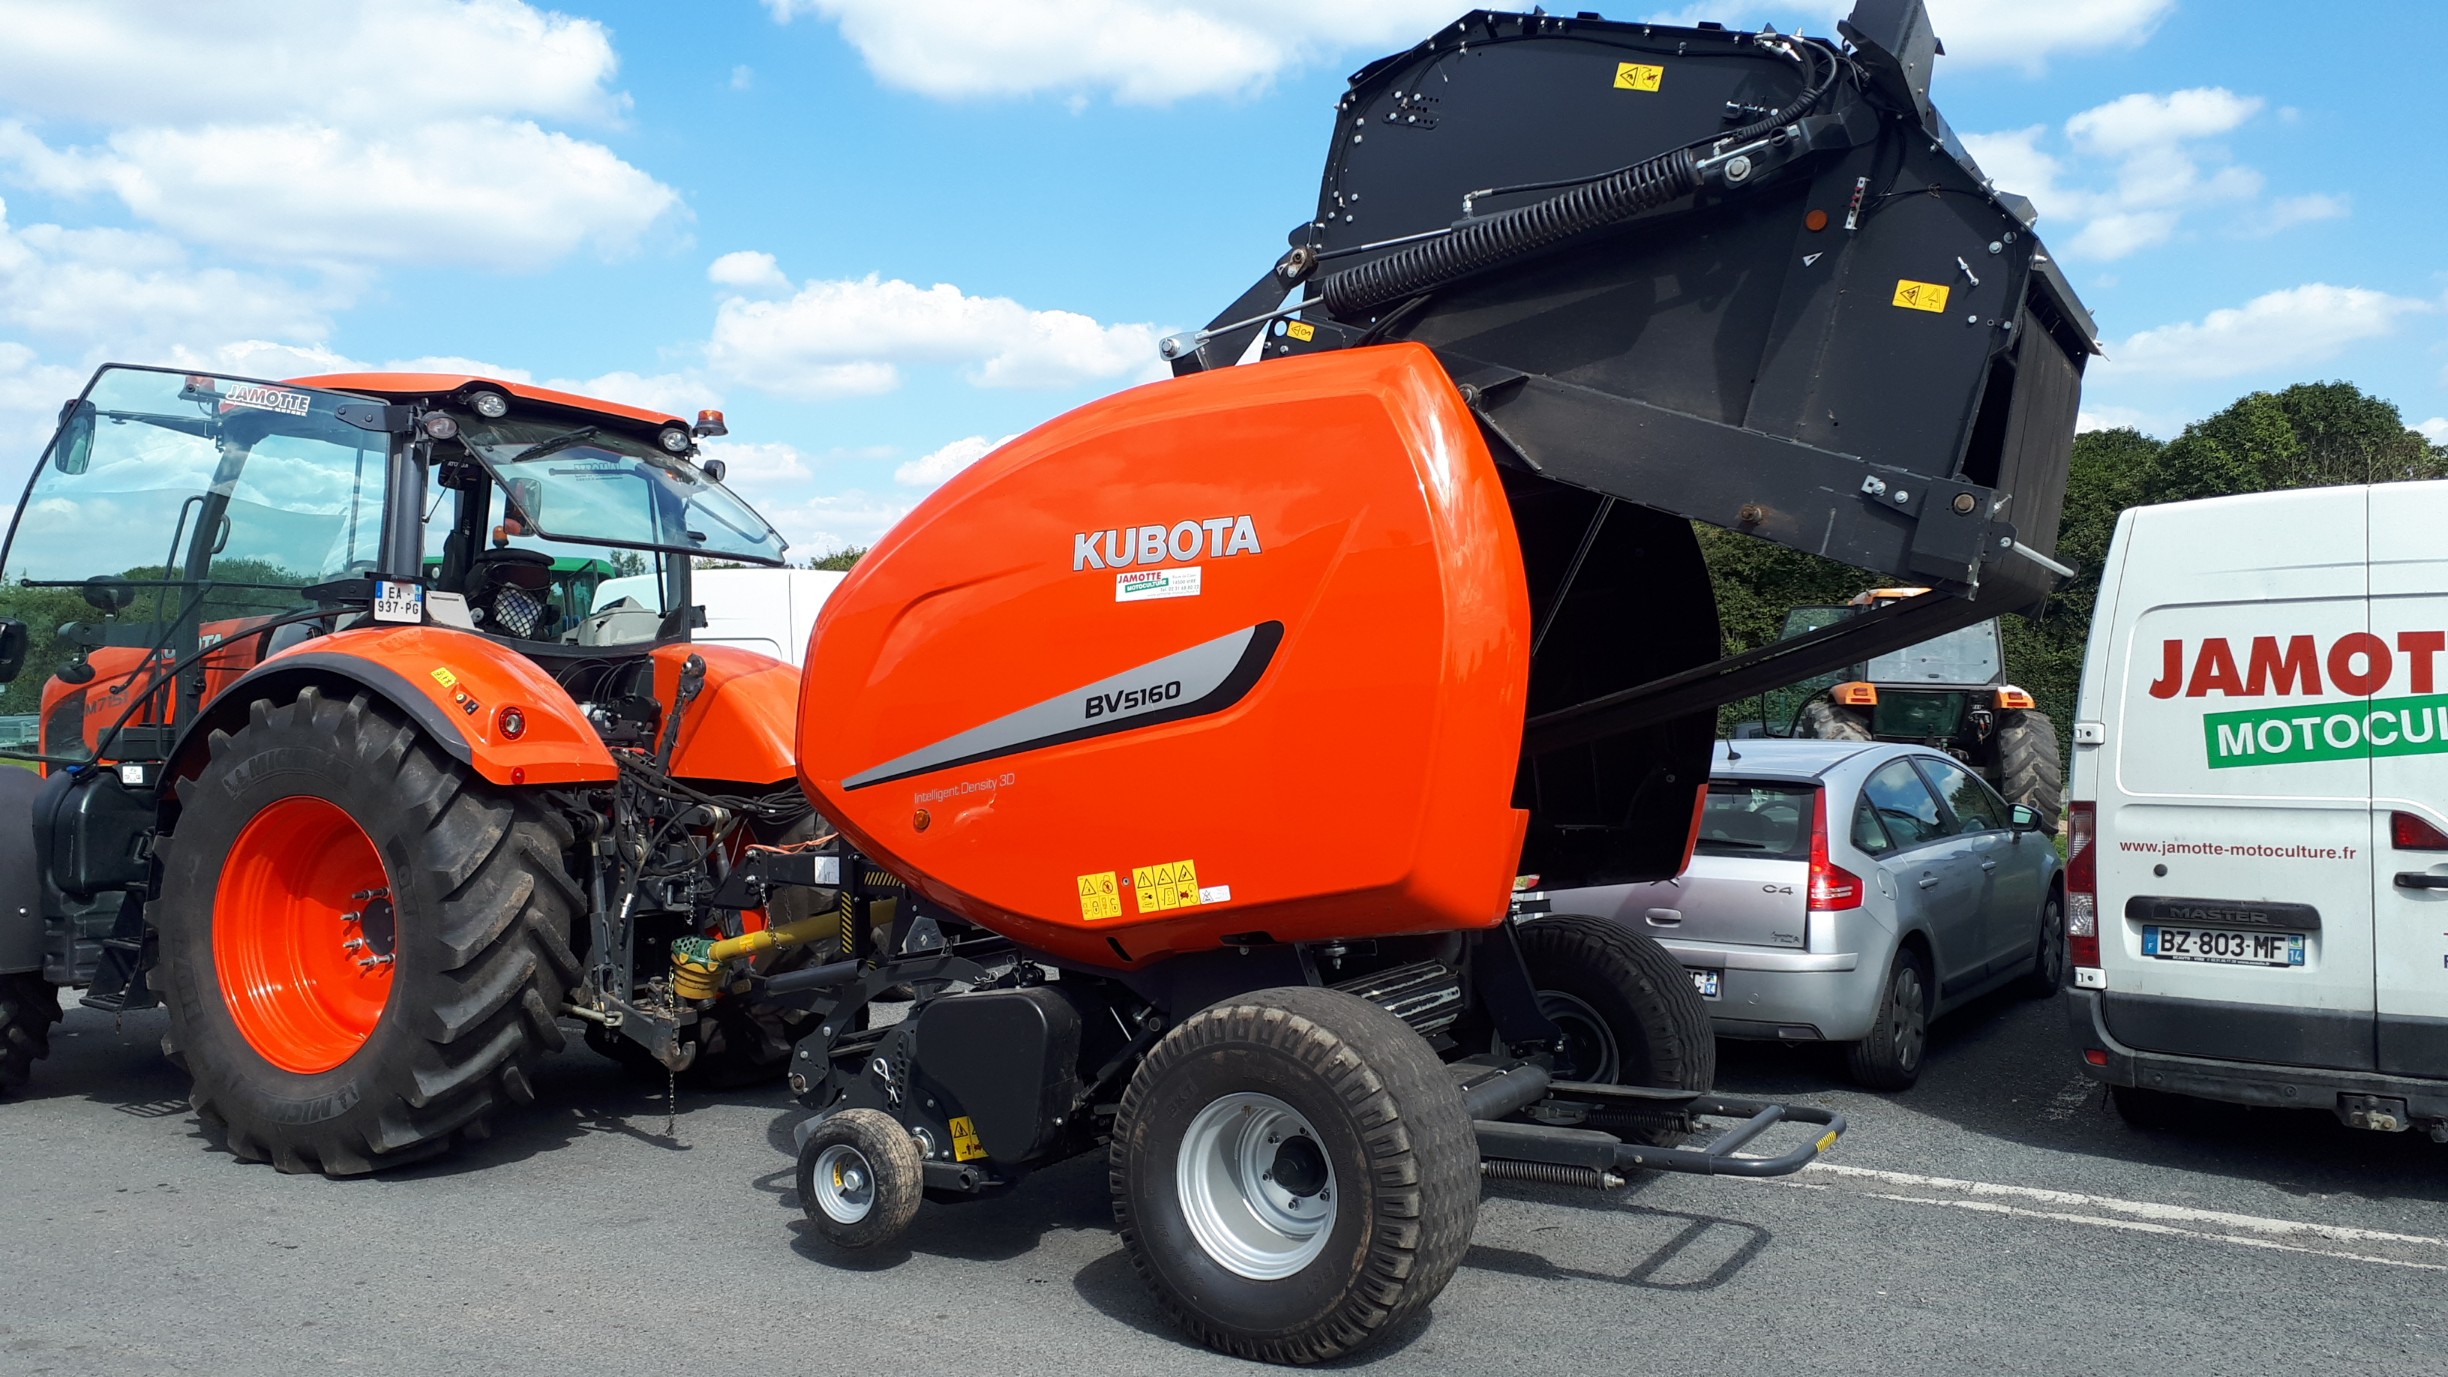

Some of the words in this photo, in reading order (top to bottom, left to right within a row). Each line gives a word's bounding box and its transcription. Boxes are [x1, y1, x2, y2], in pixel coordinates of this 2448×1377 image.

[225, 384, 311, 412] JAMOTTE
[1073, 514, 1262, 571] KUBOTA
[1118, 572, 1161, 584] JAMOTTE
[1126, 579, 1167, 592] MOTOCULTURE
[378, 600, 419, 615] 937-PG
[2148, 631, 2448, 699] JAMOT
[1085, 680, 1181, 719] BV5160
[914, 786, 959, 804] Intelligent
[961, 778, 997, 794] Density
[1000, 773, 1015, 787] 3D
[2120, 841, 2357, 860] www.jamotte-motoculture.fr
[1762, 884, 1794, 896] C4
[2169, 907, 2269, 923] MASTER
[2160, 930, 2286, 959] BZ-803-MF
[2289, 950, 2301, 962] 14
